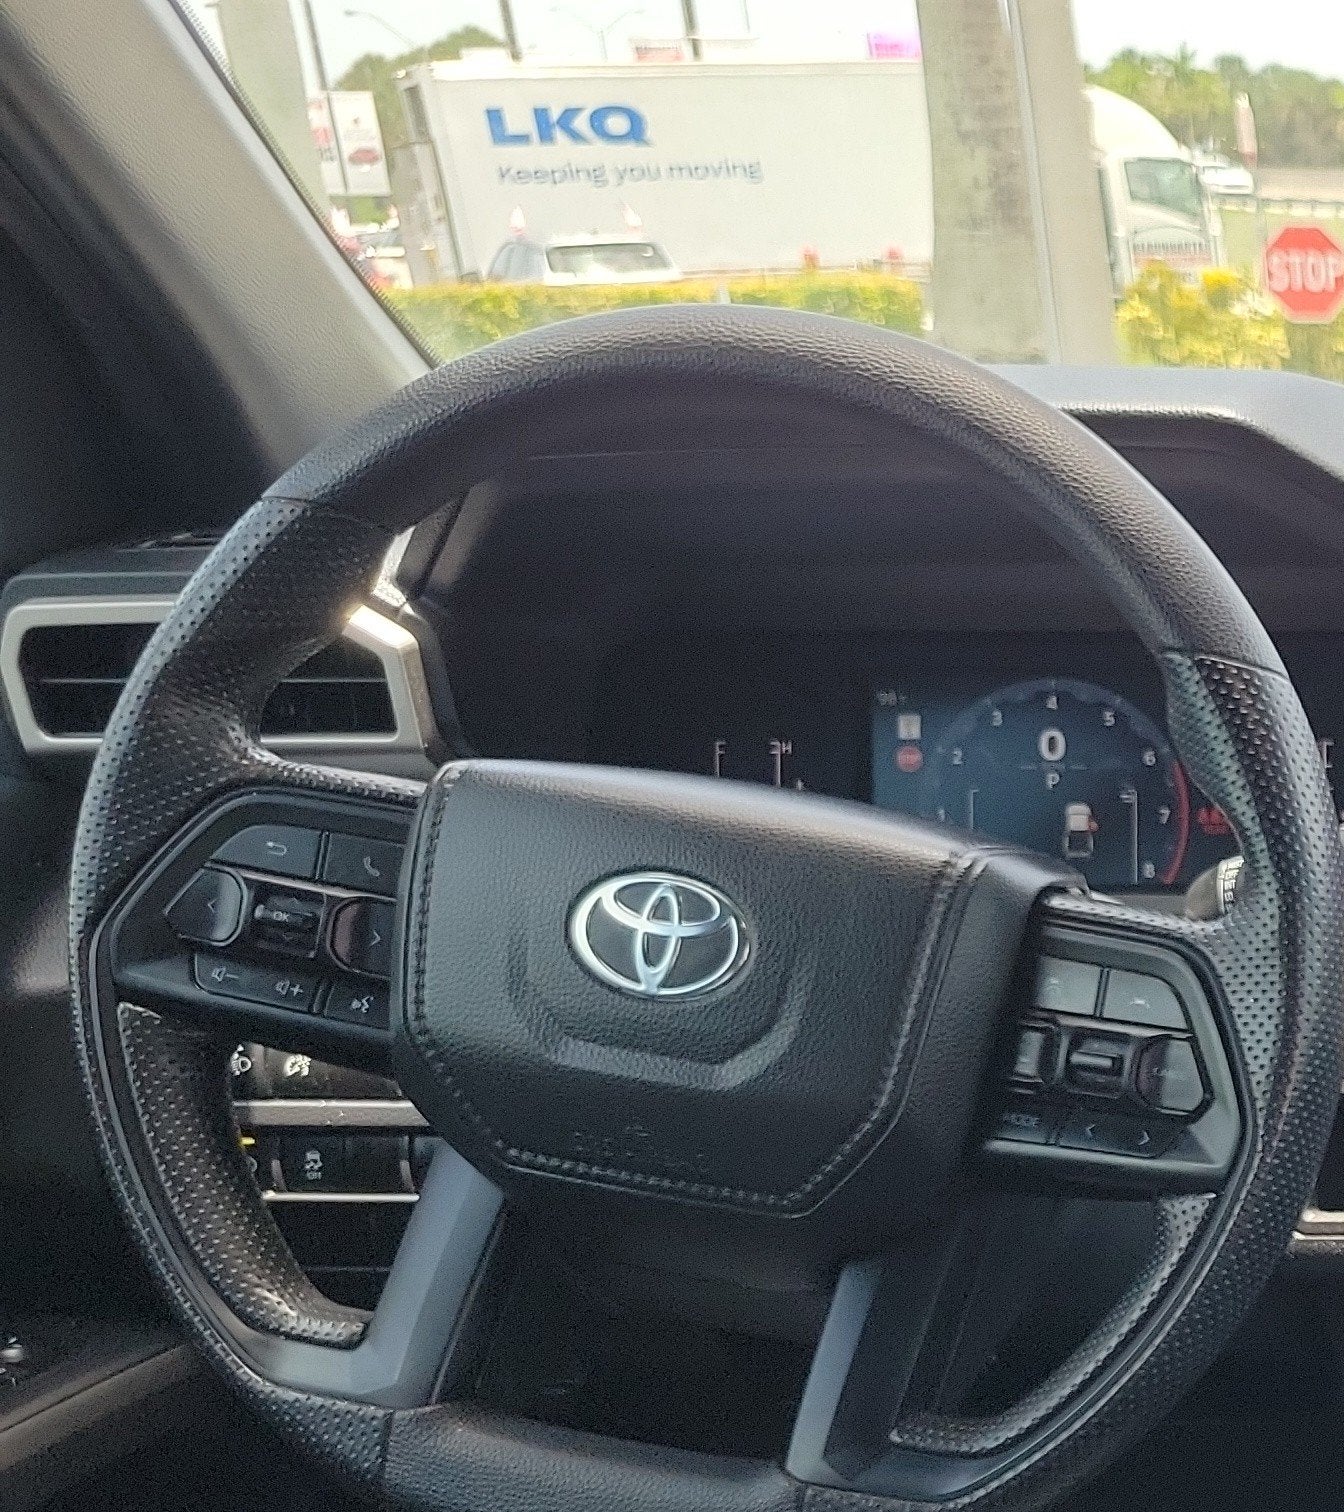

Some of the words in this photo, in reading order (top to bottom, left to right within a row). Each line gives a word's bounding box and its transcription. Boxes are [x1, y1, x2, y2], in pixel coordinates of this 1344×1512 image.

[485, 104, 653, 146] LKQ
[498, 160, 608, 186] Keeping
[614, 164, 662, 186] you
[667, 157, 763, 183] moving
[1103, 710, 1115, 727] 5
[1039, 727, 1066, 762] 0
[1142, 751, 1156, 766] 6
[1046, 770, 1060, 789] P
